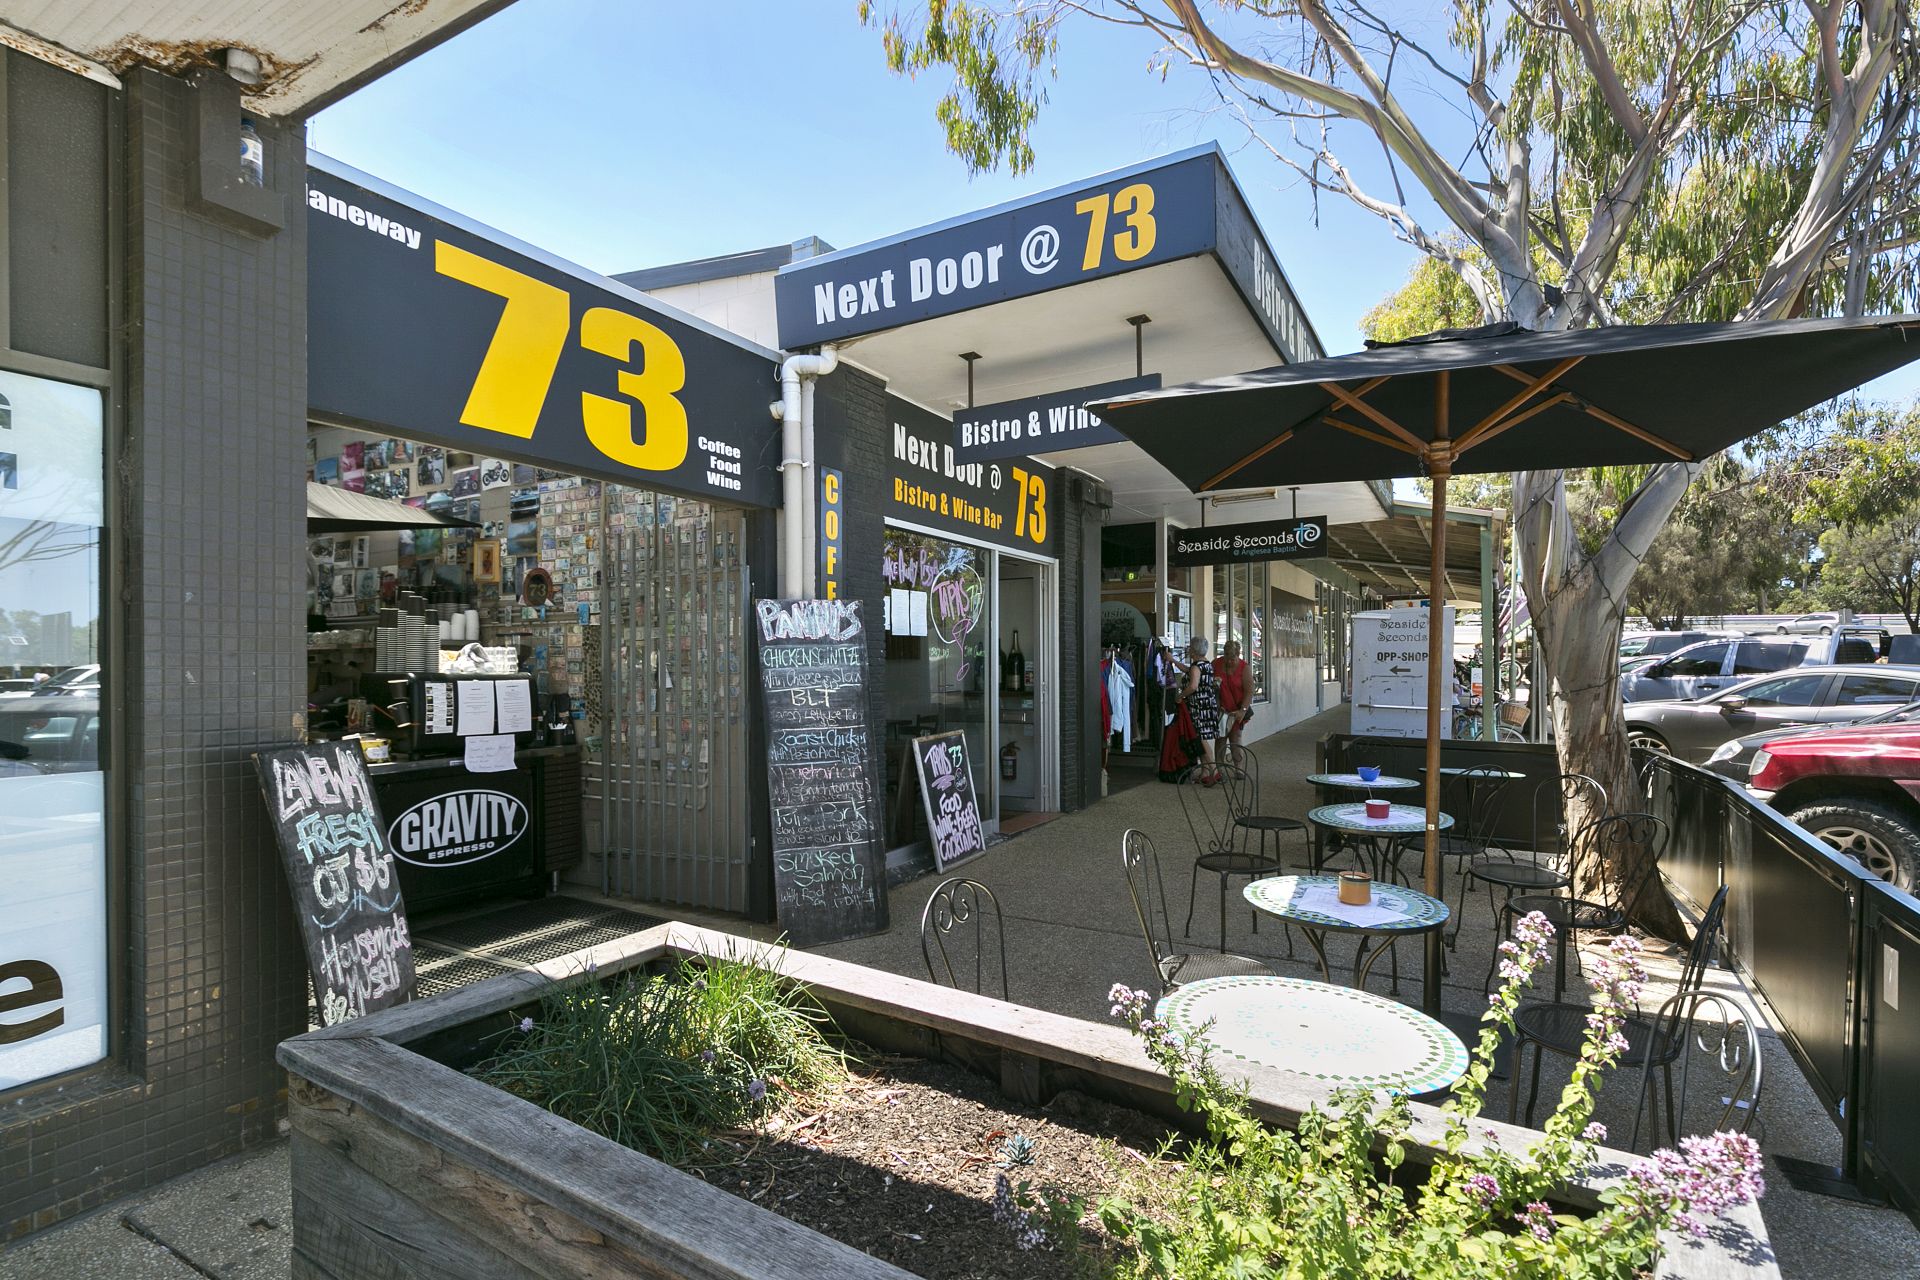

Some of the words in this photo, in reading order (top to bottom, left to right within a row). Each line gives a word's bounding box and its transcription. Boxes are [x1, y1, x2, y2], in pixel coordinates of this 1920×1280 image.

[305, 183, 421, 249] aneway
[814, 269, 896, 325] Next
[909, 243, 1003, 302] Door
[1020, 224, 1060, 275] @
[1075, 183, 1157, 271] 73
[1253, 238, 1286, 342] Bistro
[1288, 302, 1296, 357] &
[1297, 317, 1315, 363] Wi
[435, 238, 689, 471] 73
[962, 417, 1022, 448] Bistro
[1028, 411, 1041, 438] &
[698, 436, 741, 459] Coffee
[709, 456, 741, 475] Food
[707, 471, 741, 491] Wine
[893, 422, 938, 473] Next
[990, 463, 1002, 491] @
[1012, 466, 1047, 544] 73
[894, 477, 937, 513] Bistro
[940, 492, 949, 514] &
[952, 496, 981, 526] Wine
[984, 506, 1003, 530] Bar
[1177, 538, 1231, 553] Seaside
[1233, 531, 1295, 549] Seconds
[1241, 547, 1273, 557] Anglesea
[1273, 545, 1297, 555] Baptist
[527, 583, 547, 596] 73
[1101, 607, 1132, 618] aside
[1380, 618, 1426, 630] Seaside
[1377, 631, 1428, 642] Seconds
[1377, 651, 1429, 663] OPP-SHOP
[948, 744, 963, 768] 73
[272, 746, 375, 824] LANEWAY
[939, 791, 962, 817] FOOD
[296, 807, 384, 864] FRESH
[400, 793, 518, 853] GRAVITY
[428, 841, 496, 860] ESPRESSO
[940, 827, 981, 861] COCKTAILS
[313, 852, 351, 908] OJ
